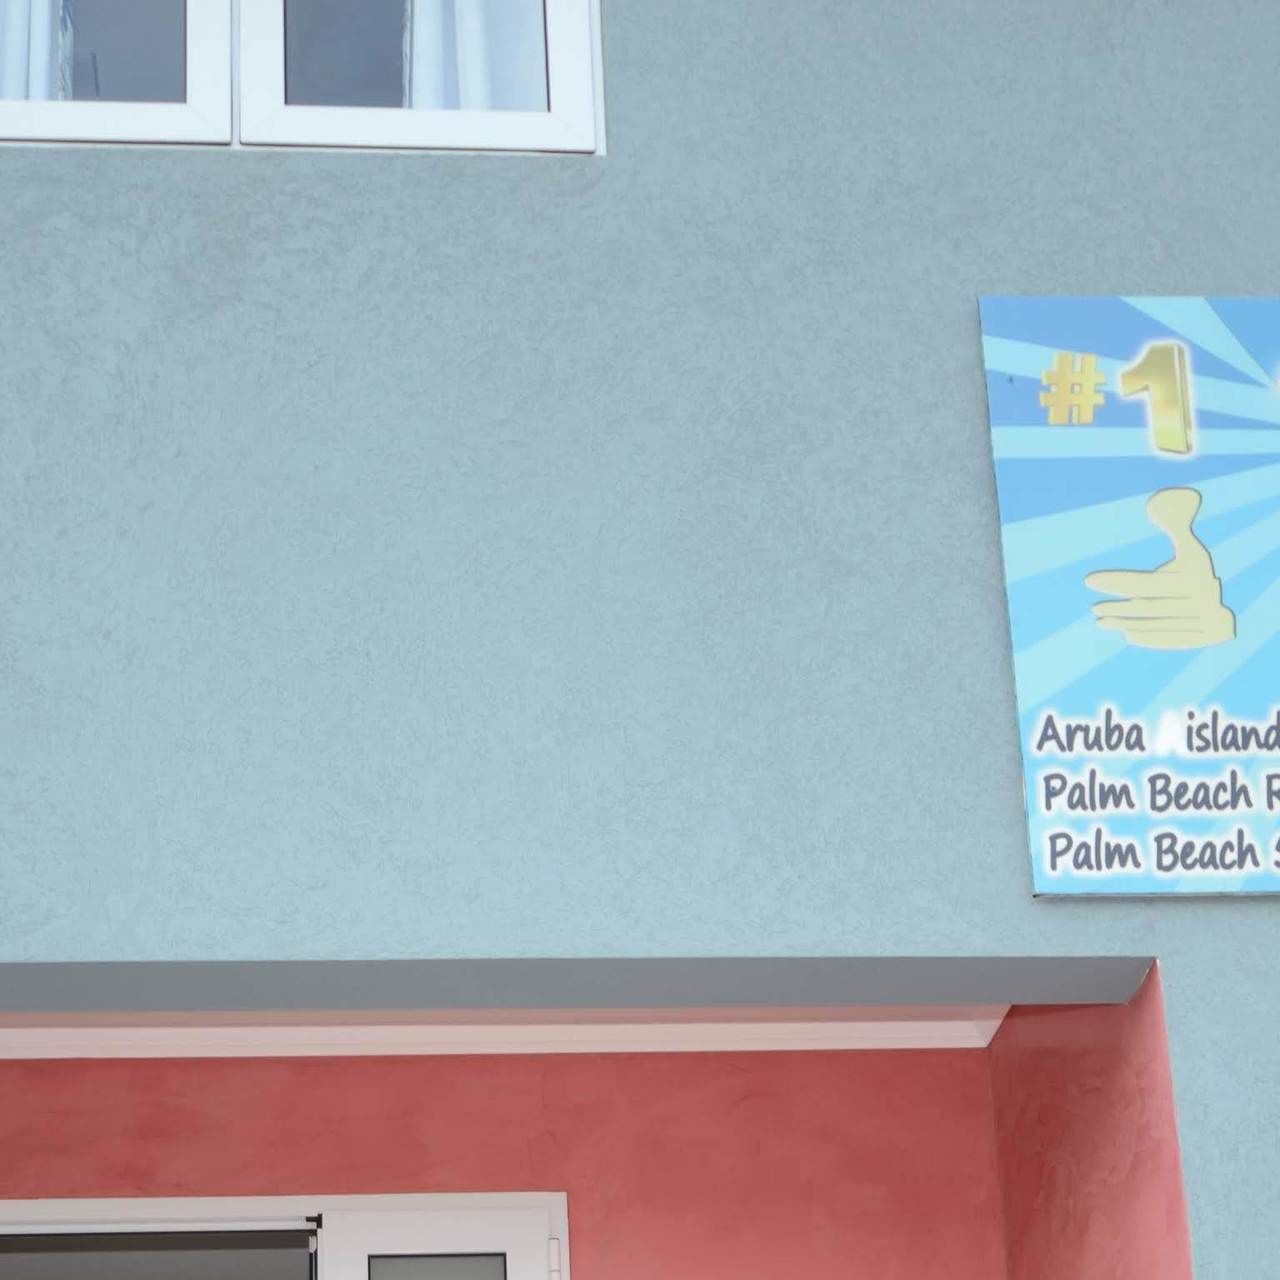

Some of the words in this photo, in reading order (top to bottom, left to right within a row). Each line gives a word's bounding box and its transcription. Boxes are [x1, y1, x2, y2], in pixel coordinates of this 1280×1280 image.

[1036, 708, 1146, 752] Aruba
[1043, 769, 1135, 812] Palm
[1148, 769, 1253, 813] Beach
[1049, 828, 1141, 871] Palm
[1154, 829, 1260, 872] Beach
